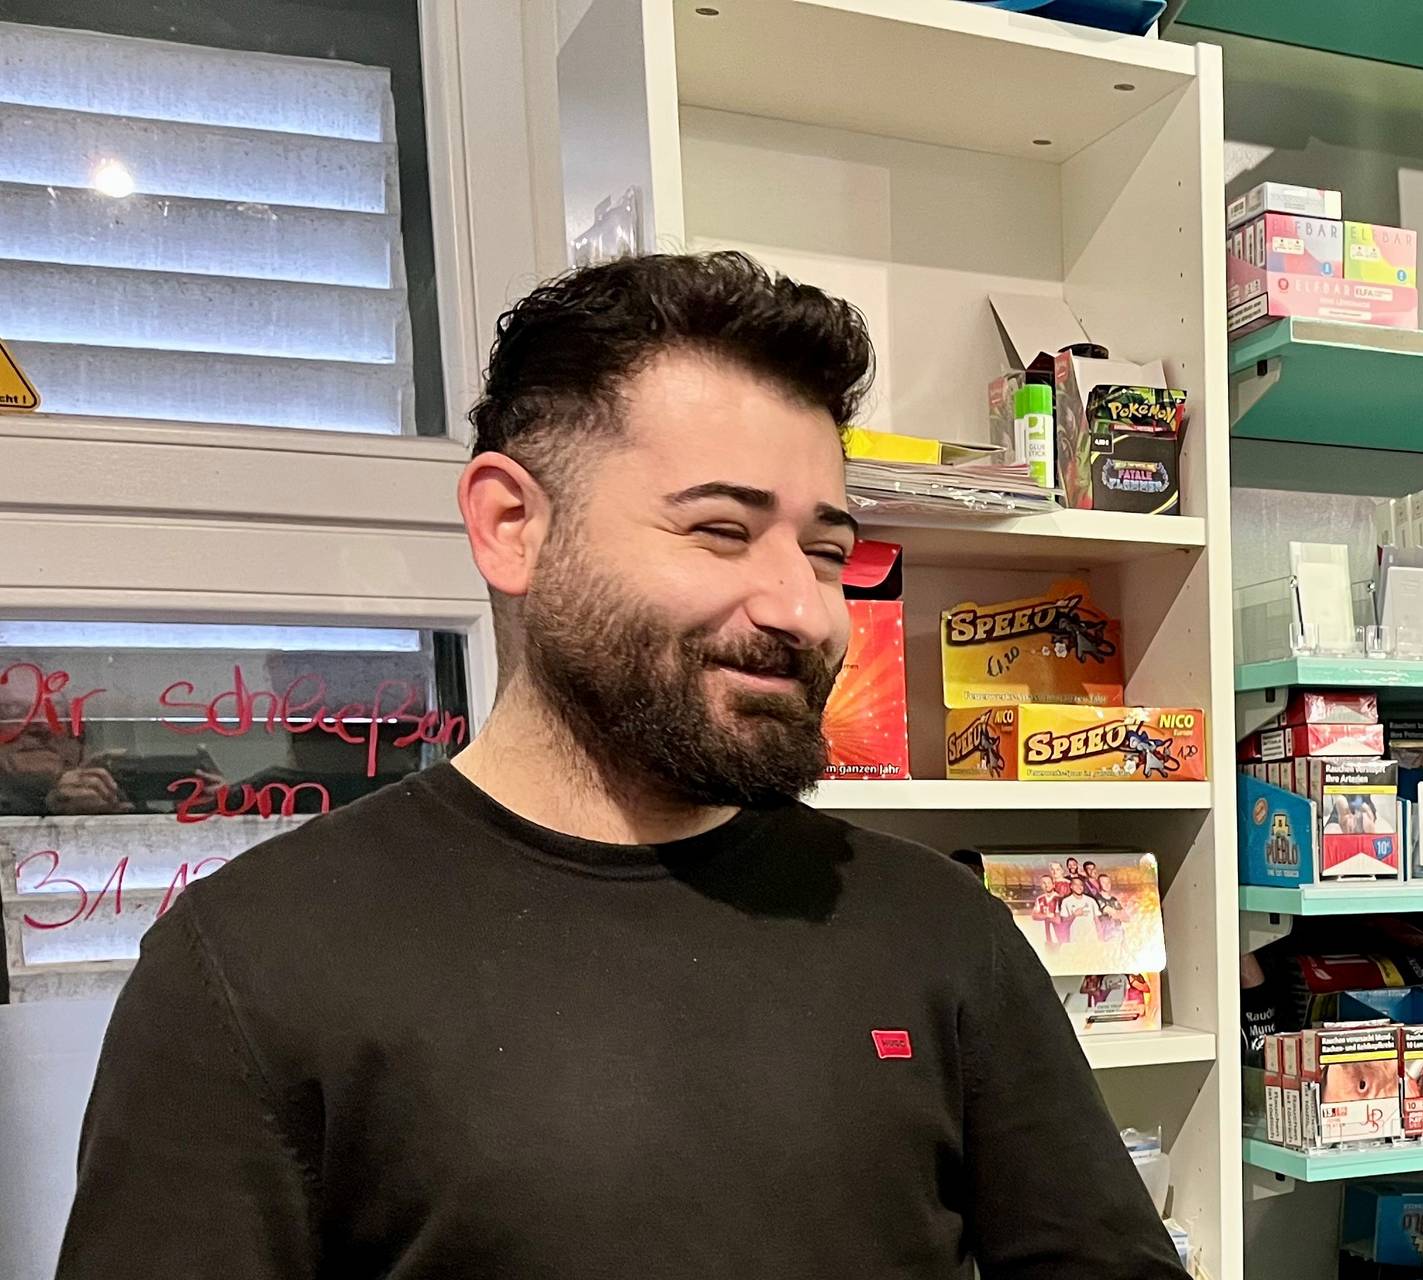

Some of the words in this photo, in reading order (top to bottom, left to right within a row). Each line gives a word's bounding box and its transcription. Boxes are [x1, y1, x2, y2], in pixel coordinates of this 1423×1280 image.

[1159, 714, 1195, 728] NICO
[1177, 745, 1199, 761] 1,20
[839, 764, 877, 775] ganzen
[879, 763, 900, 775] Jahr
[167, 776, 331, 824] zum
